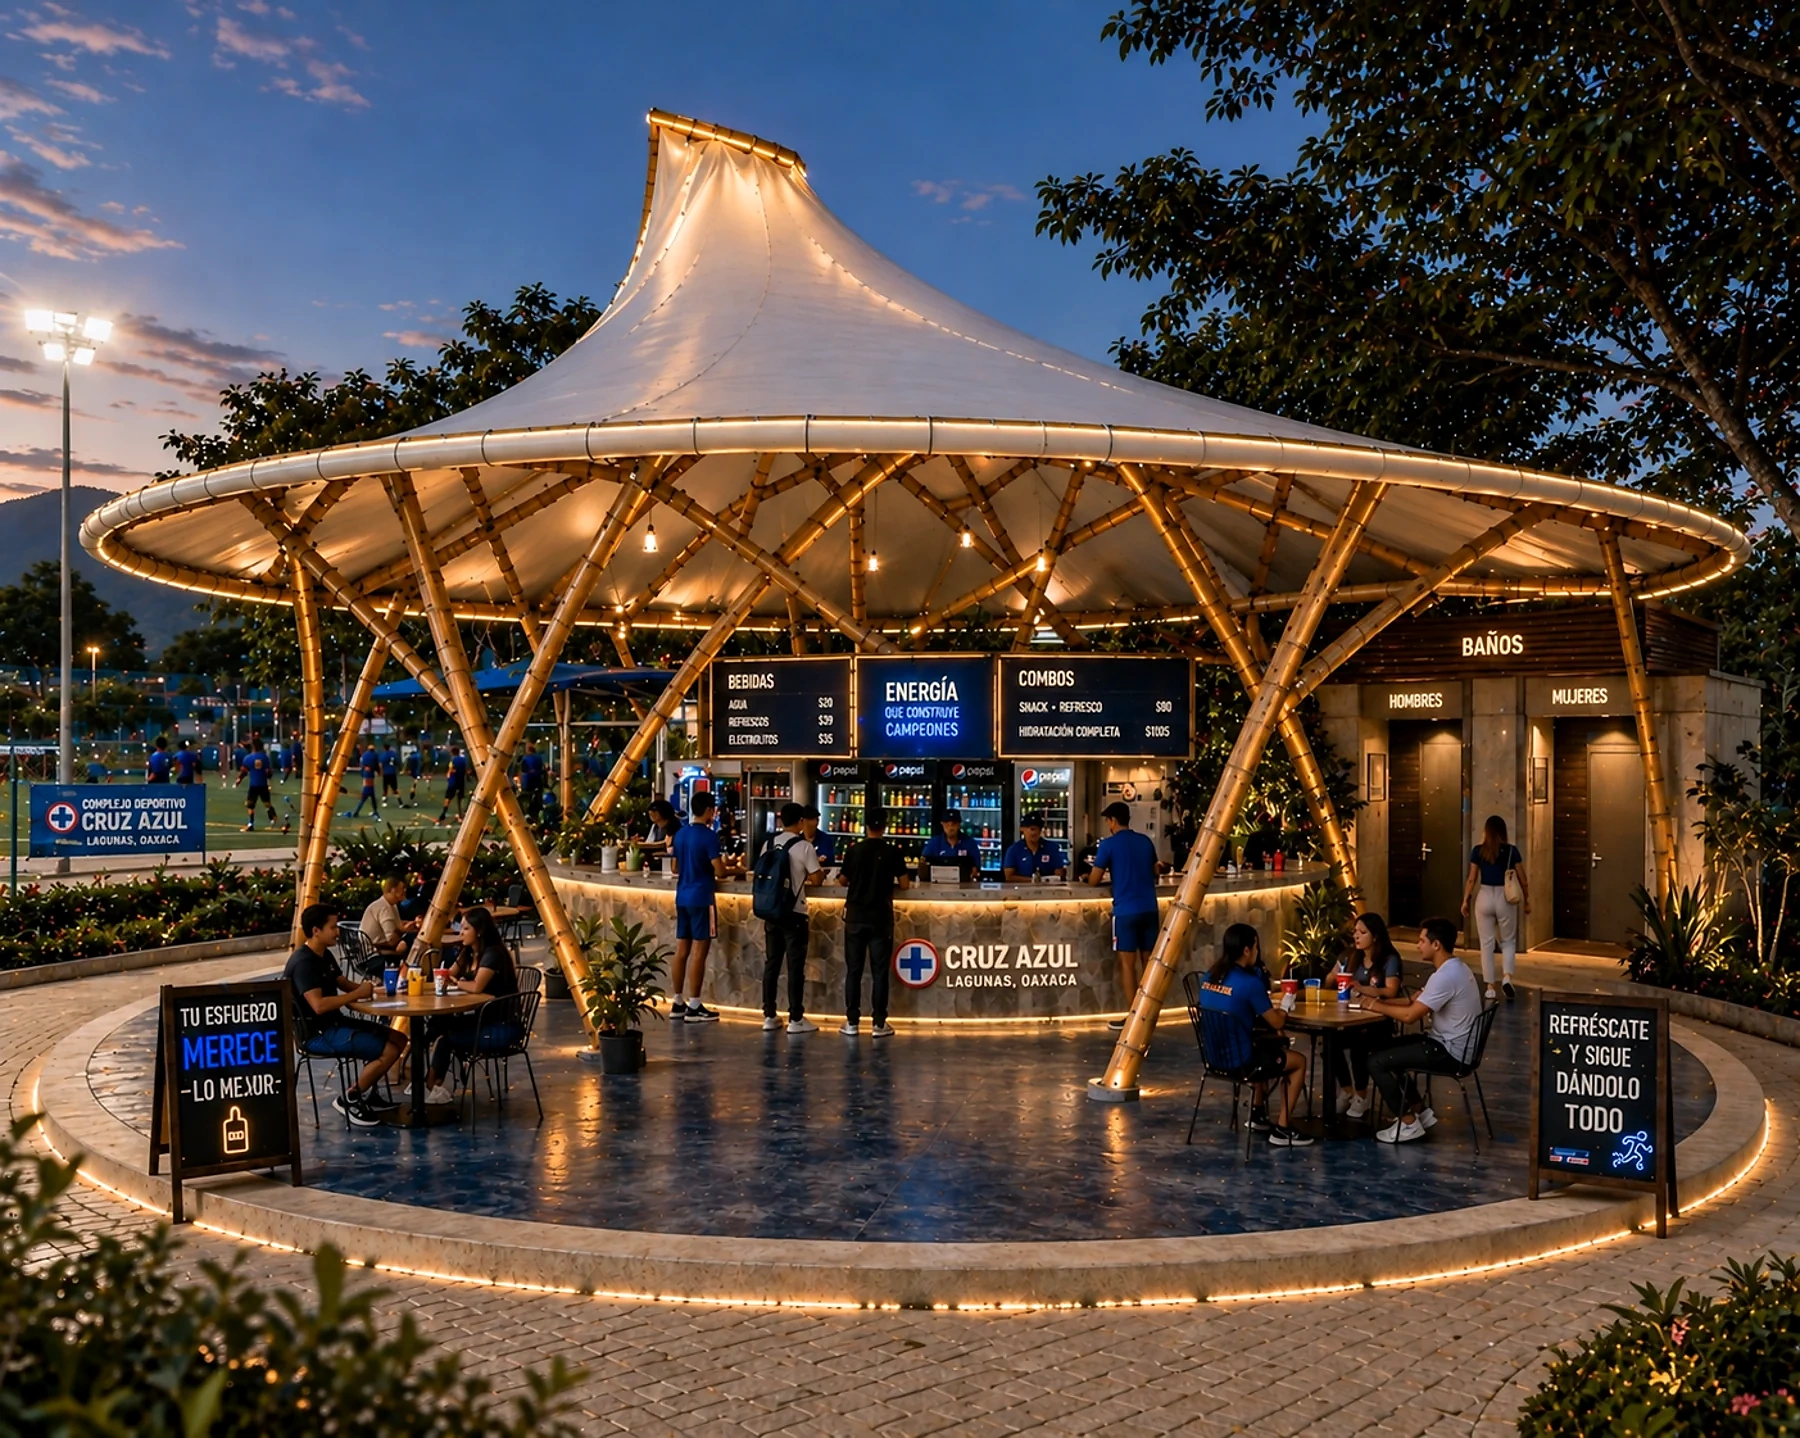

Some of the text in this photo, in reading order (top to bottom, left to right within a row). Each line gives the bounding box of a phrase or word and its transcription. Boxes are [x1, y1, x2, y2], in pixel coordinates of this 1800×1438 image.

[1462, 630, 1524, 657] BAÑOS
[728, 673, 775, 690] BEBIDAS
[885, 675, 959, 702] ENERGÍA
[1018, 670, 1075, 687] COMBOS
[1389, 693, 1443, 709] HOMBRES
[1552, 688, 1608, 705] MUJERES
[884, 706, 904, 719] QUE
[885, 722, 959, 737] CAMPEONES
[82, 811, 188, 831] CRUZ AZUL
[140, 834, 180, 845] OAXACA
[945, 944, 1078, 969] CRUZ AZUL
[946, 973, 1077, 988] LAGUNAS, OAXACA
[180, 1002, 278, 1027] TU ESFUERZO
[1549, 1012, 1650, 1041] REFRÉSCATE
[183, 1031, 280, 1071] MERECE
[1569, 1044, 1632, 1068] Y SIGUE
[1556, 1068, 1641, 1101] DÁNDOLO
[1564, 1103, 1624, 1134] TODO
